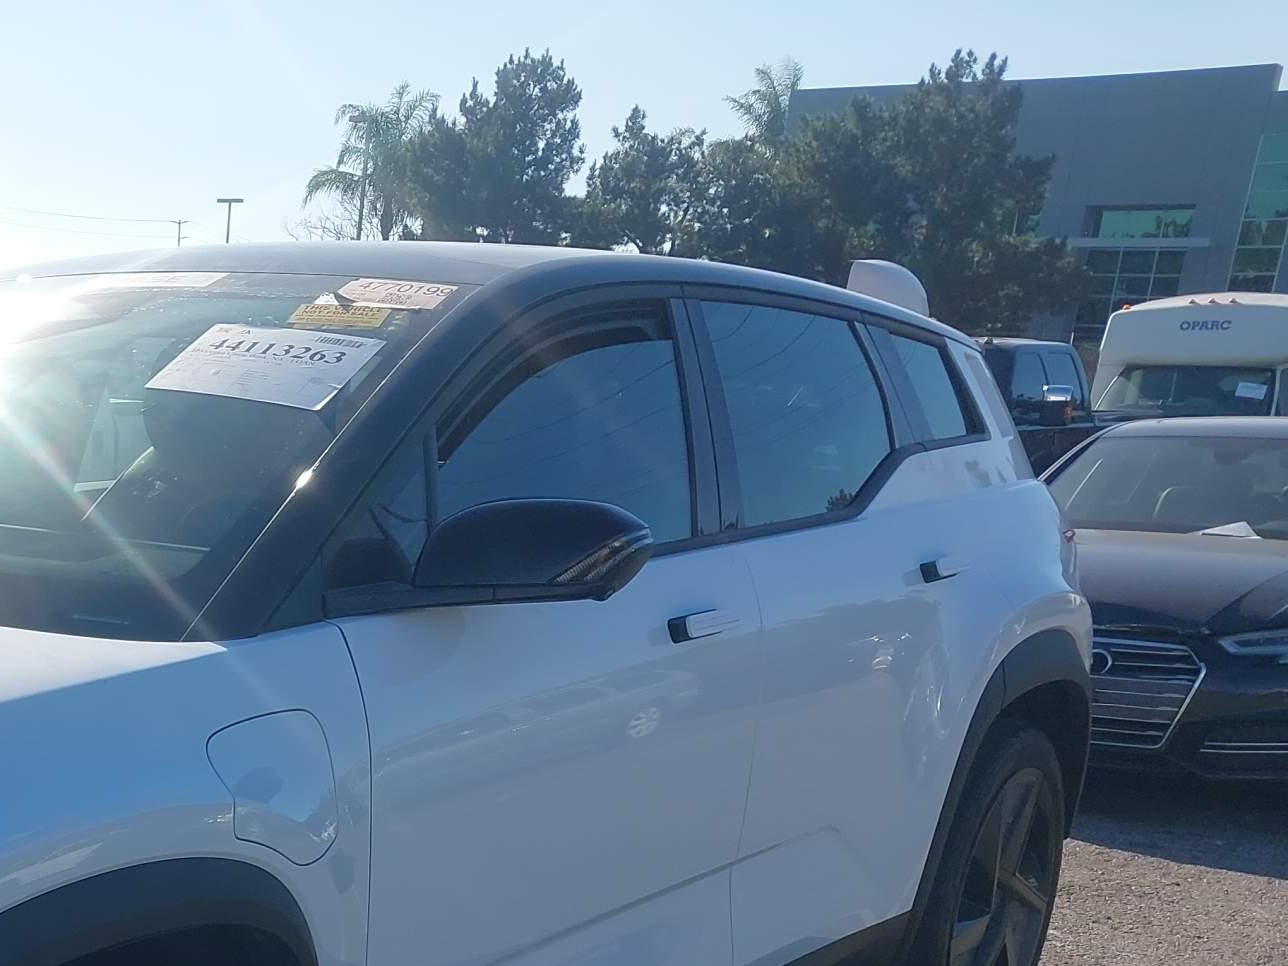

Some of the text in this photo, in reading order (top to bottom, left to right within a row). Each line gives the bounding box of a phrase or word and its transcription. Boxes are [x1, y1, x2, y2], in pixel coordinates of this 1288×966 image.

[360, 281, 453, 297] 4770199
[1179, 320, 1233, 331] OPARC
[208, 338, 347, 365] 44113263
